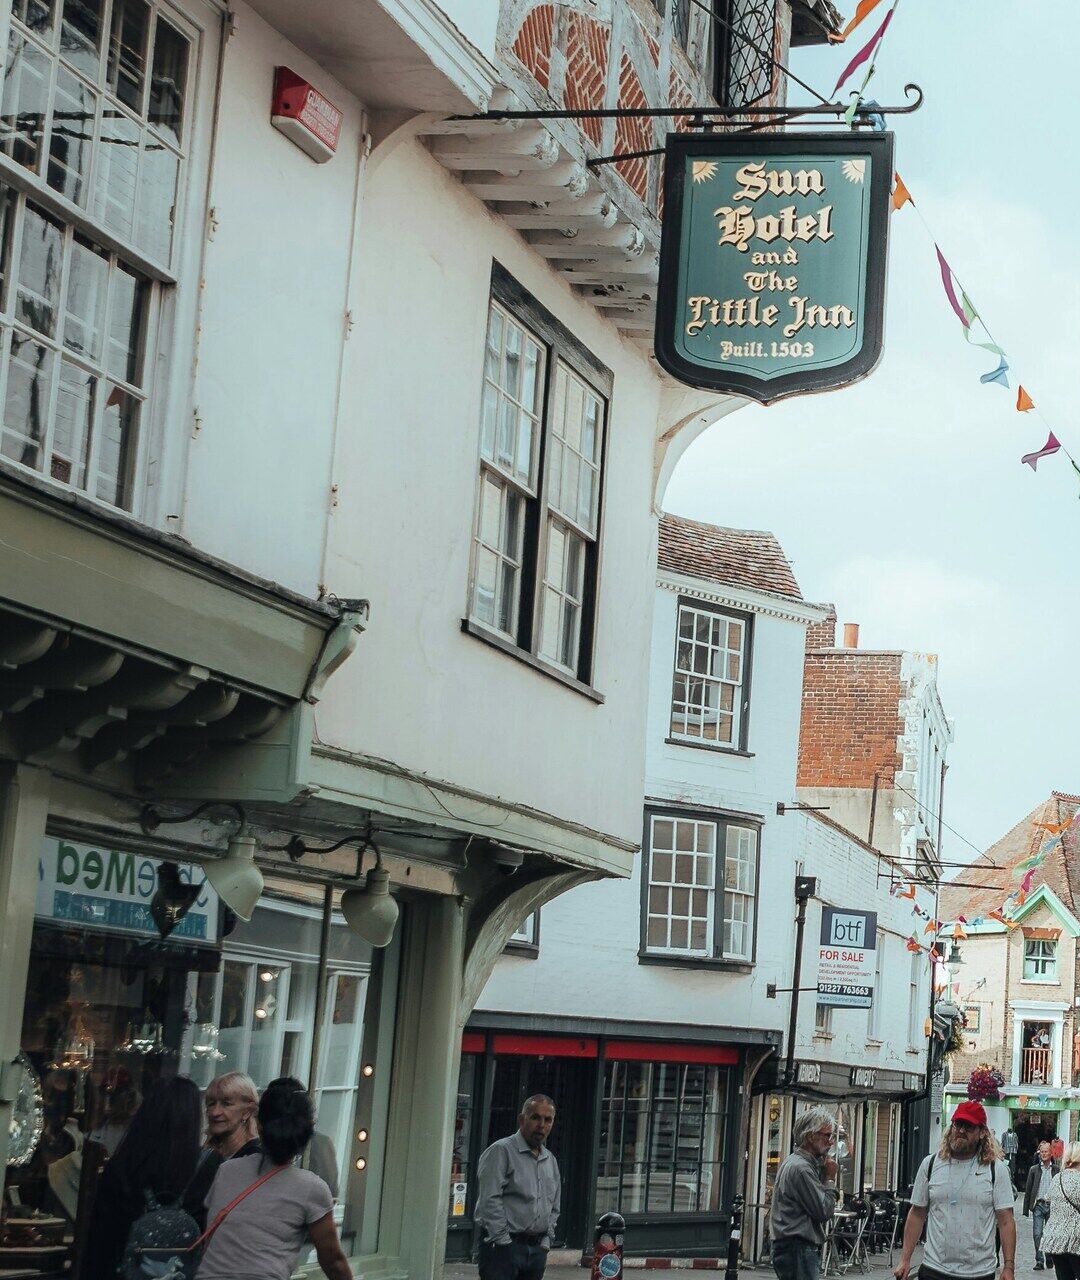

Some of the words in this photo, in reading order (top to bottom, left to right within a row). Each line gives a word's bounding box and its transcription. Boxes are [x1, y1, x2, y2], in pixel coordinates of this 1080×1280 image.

[733, 160, 826, 201] Sun
[714, 204, 835, 251] Hotel
[751, 246, 799, 266] and
[743, 270, 799, 293] The
[686, 295, 780, 336] Little
[783, 295, 856, 338] Inn
[771, 341, 814, 359] 1503
[833, 918, 862, 942] btf
[819, 949, 839, 961] FOR
[841, 951, 864, 962] SALE
[818, 983, 841, 994] 01227
[842, 985, 869, 996] 763663
